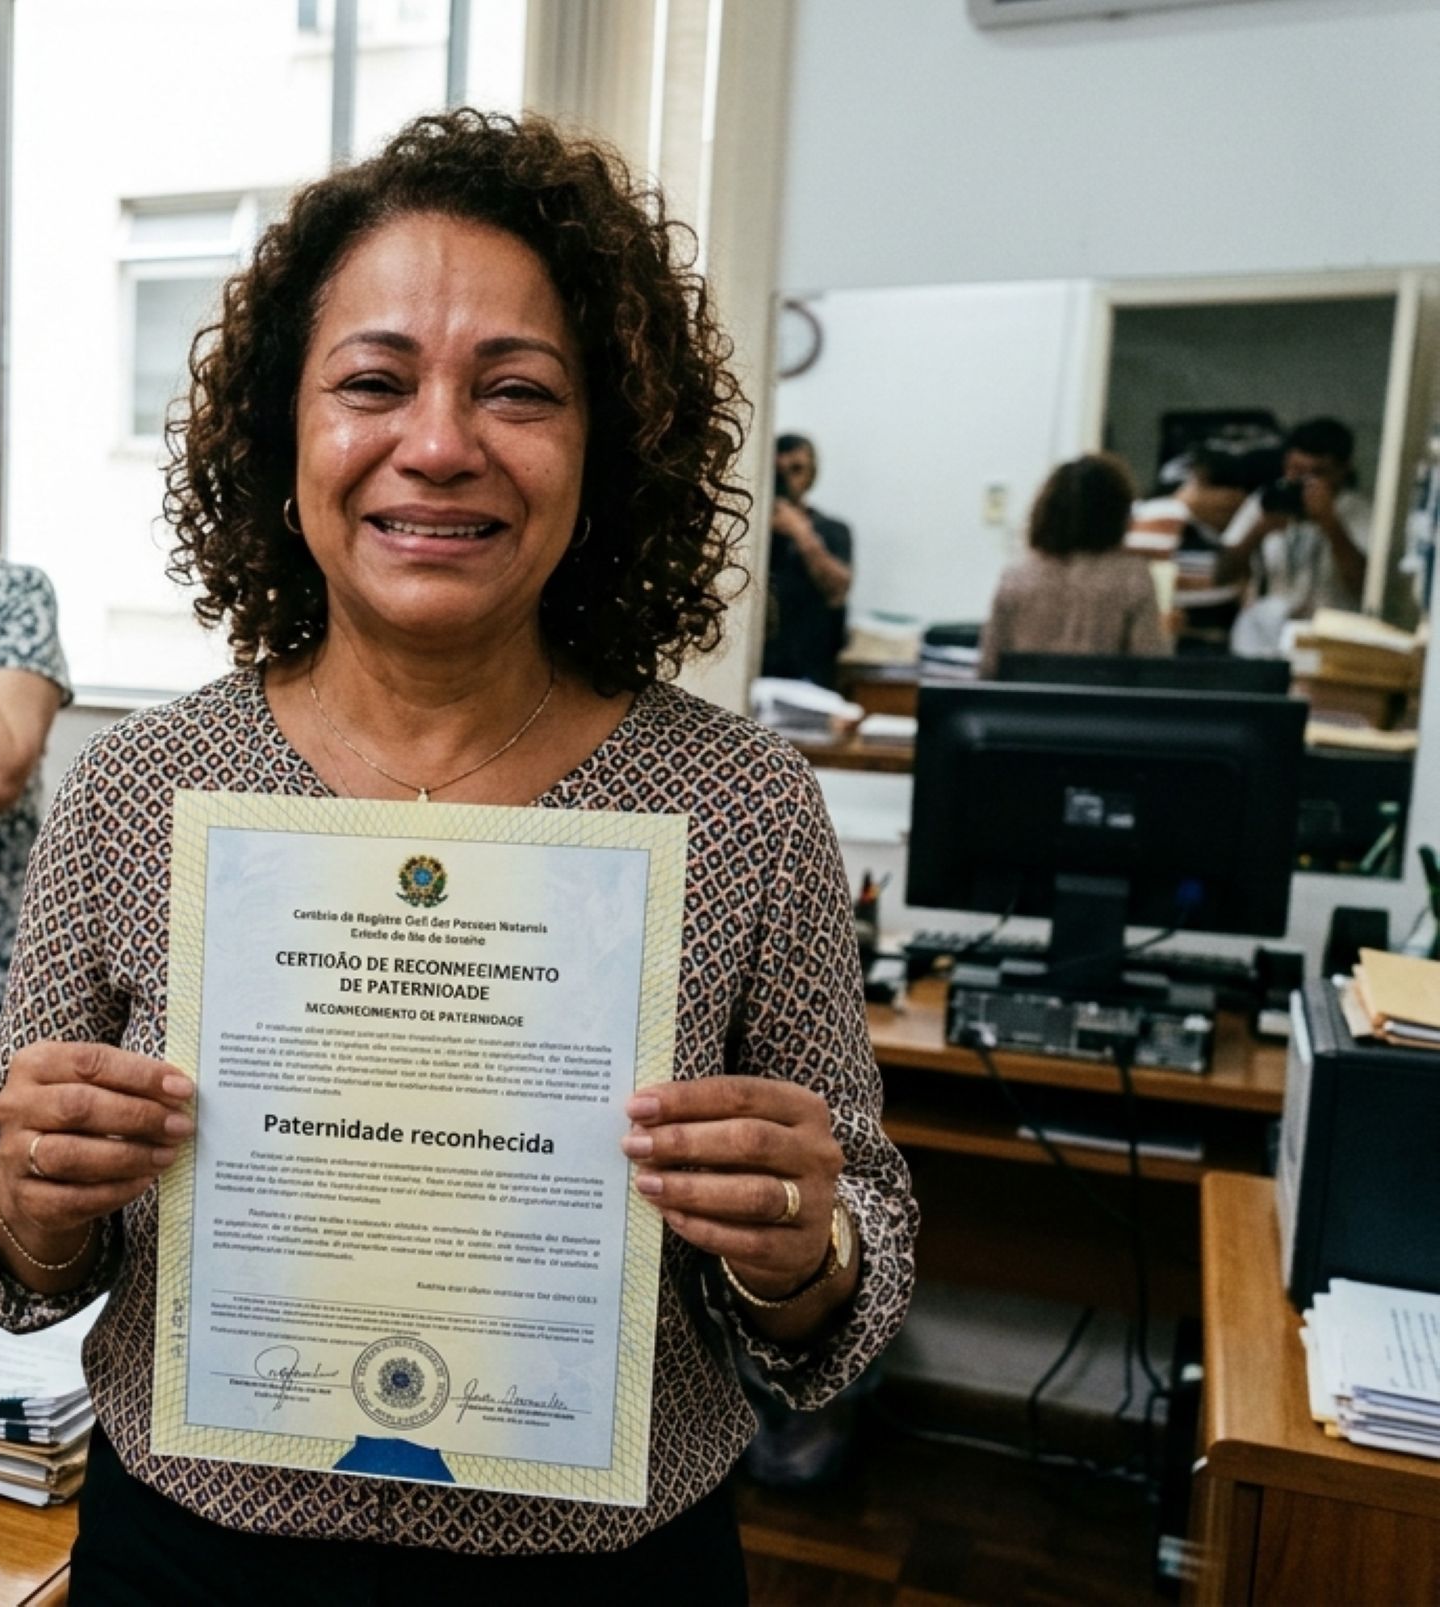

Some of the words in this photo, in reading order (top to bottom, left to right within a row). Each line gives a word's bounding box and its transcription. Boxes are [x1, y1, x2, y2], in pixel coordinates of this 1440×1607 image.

[367, 956, 389, 972] DE
[340, 978, 362, 993] DE
[263, 1113, 405, 1145] Paternidade
[410, 1127, 556, 1156] reconhecida
